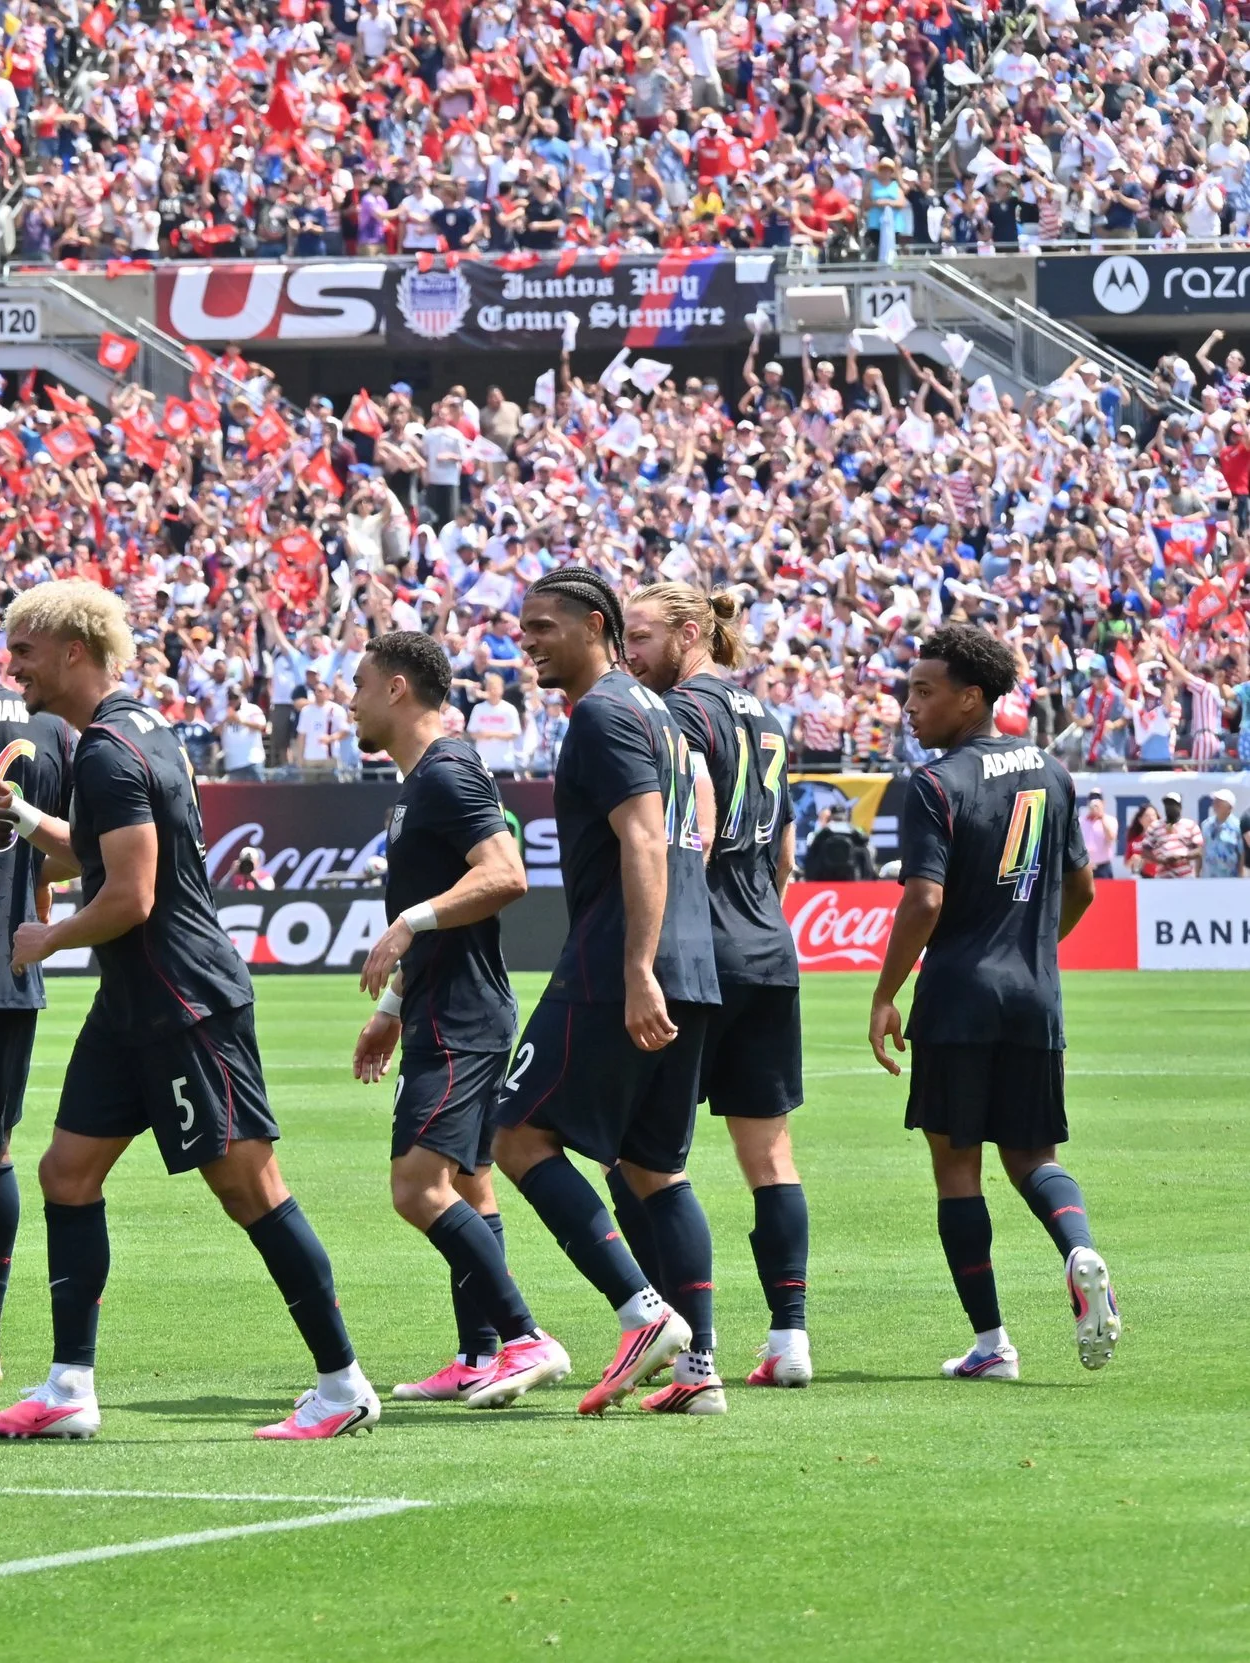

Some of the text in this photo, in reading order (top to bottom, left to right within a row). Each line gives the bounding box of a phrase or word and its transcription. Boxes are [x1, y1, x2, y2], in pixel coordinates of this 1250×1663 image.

[502, 268, 699, 300] Juntos Hoy
[588, 301, 725, 331] Siempre
[720, 726, 787, 844] 13
[981, 745, 1045, 780] ADAMS
[996, 788, 1047, 902] 4
[215, 902, 393, 967] GOA
[505, 1042, 535, 1091] 2
[171, 1076, 195, 1131] 5
